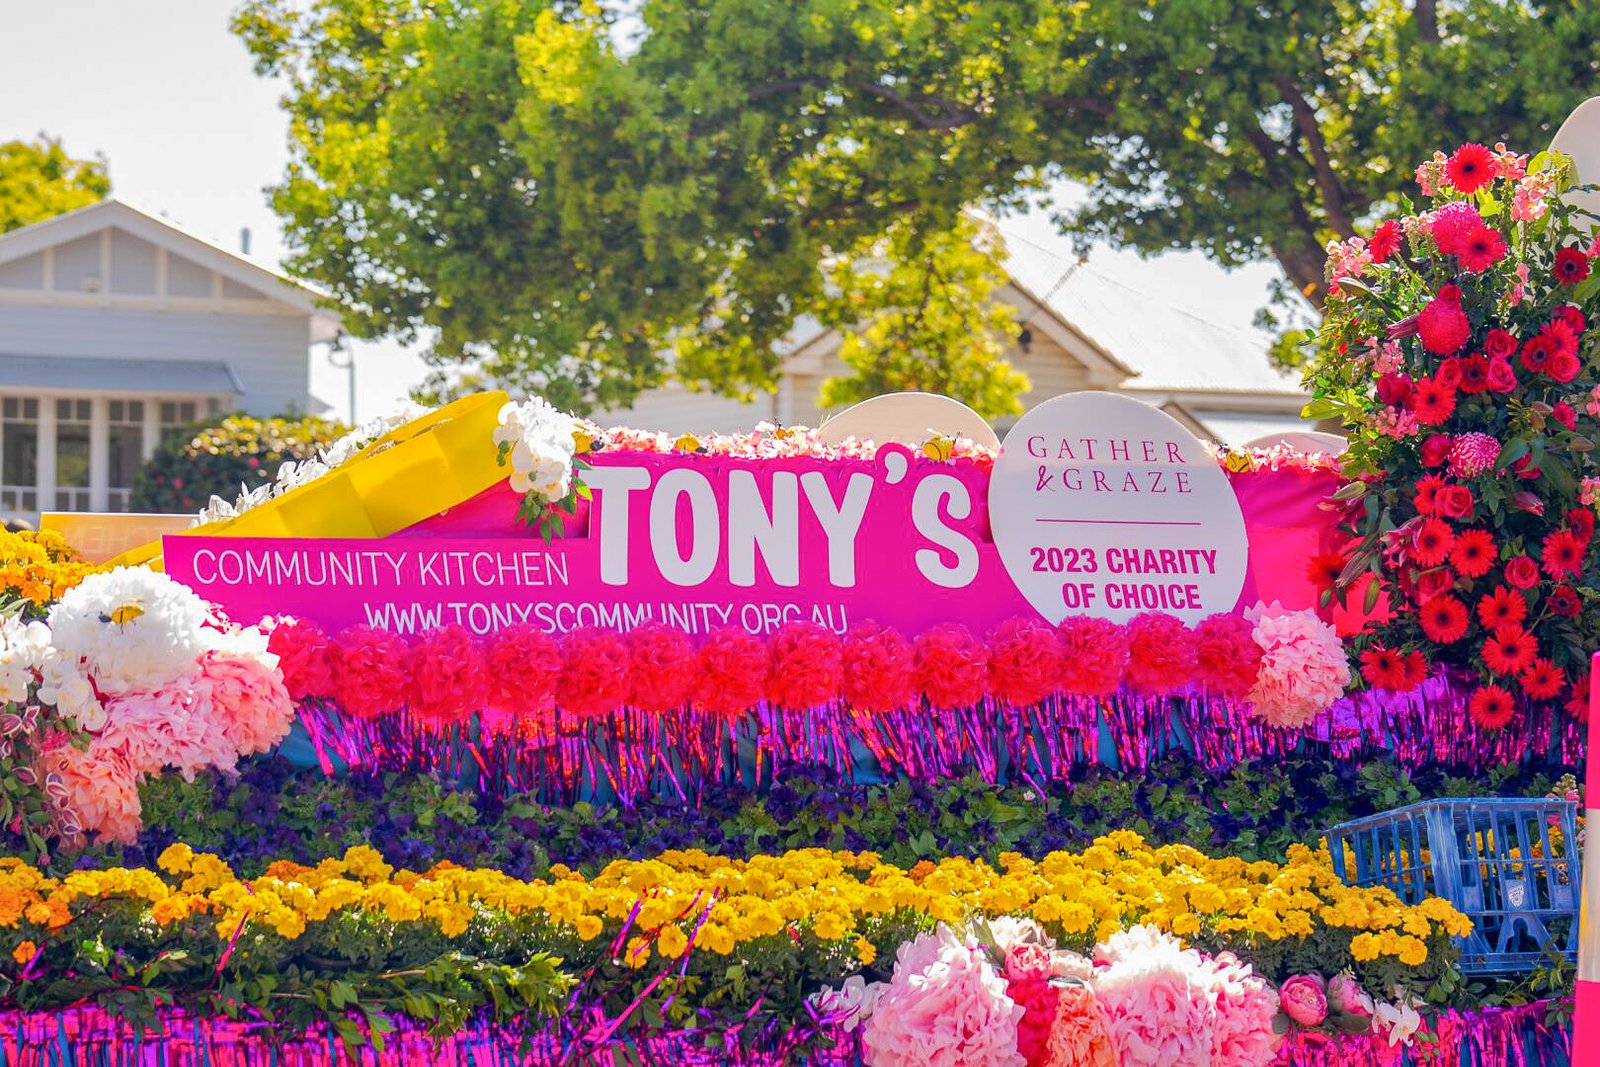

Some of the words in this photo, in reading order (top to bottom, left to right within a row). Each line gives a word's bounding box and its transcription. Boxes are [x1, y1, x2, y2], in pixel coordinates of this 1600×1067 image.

[1027, 436, 1186, 464] GATHER
[577, 451, 980, 588] TONY'S
[192, 549, 407, 587] COMMUNITY
[418, 552, 569, 586] KITCHEN
[1030, 547, 1098, 573] 2023
[1105, 548, 1217, 575] CHARITY
[1062, 583, 1096, 609] OF
[1104, 584, 1203, 610] CHOICE
